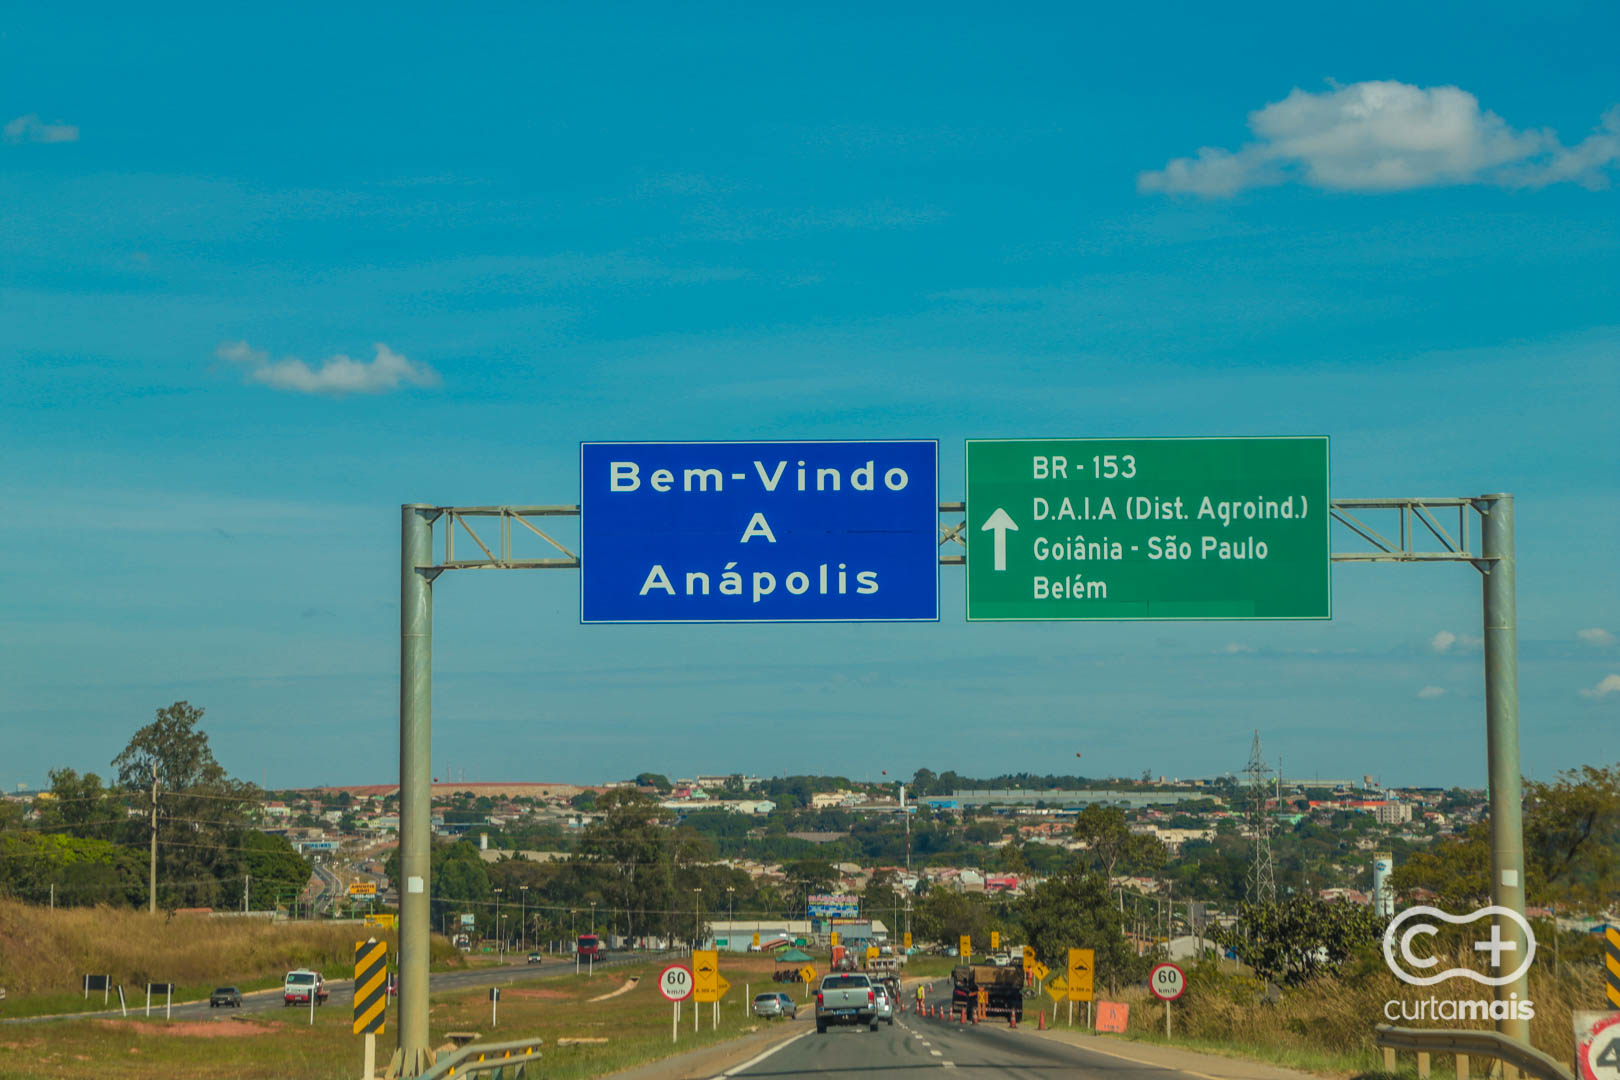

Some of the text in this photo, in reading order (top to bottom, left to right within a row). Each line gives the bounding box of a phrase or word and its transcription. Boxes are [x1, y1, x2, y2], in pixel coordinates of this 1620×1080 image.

[610, 460, 909, 492] Bem-Vindo
[1033, 455, 1068, 479] BR
[1093, 455, 1137, 479] 153
[1033, 495, 1308, 527] D.A.I.A (Dist. Agroind.)
[740, 512, 777, 543] A
[1033, 536, 1123, 561] Goiânia
[1148, 535, 1192, 560] São
[1201, 536, 1268, 560] Paulo
[639, 562, 879, 603] Anápolis
[1033, 574, 1107, 599] Belém
[667, 971, 686, 985] 60
[1158, 970, 1177, 984] 60
